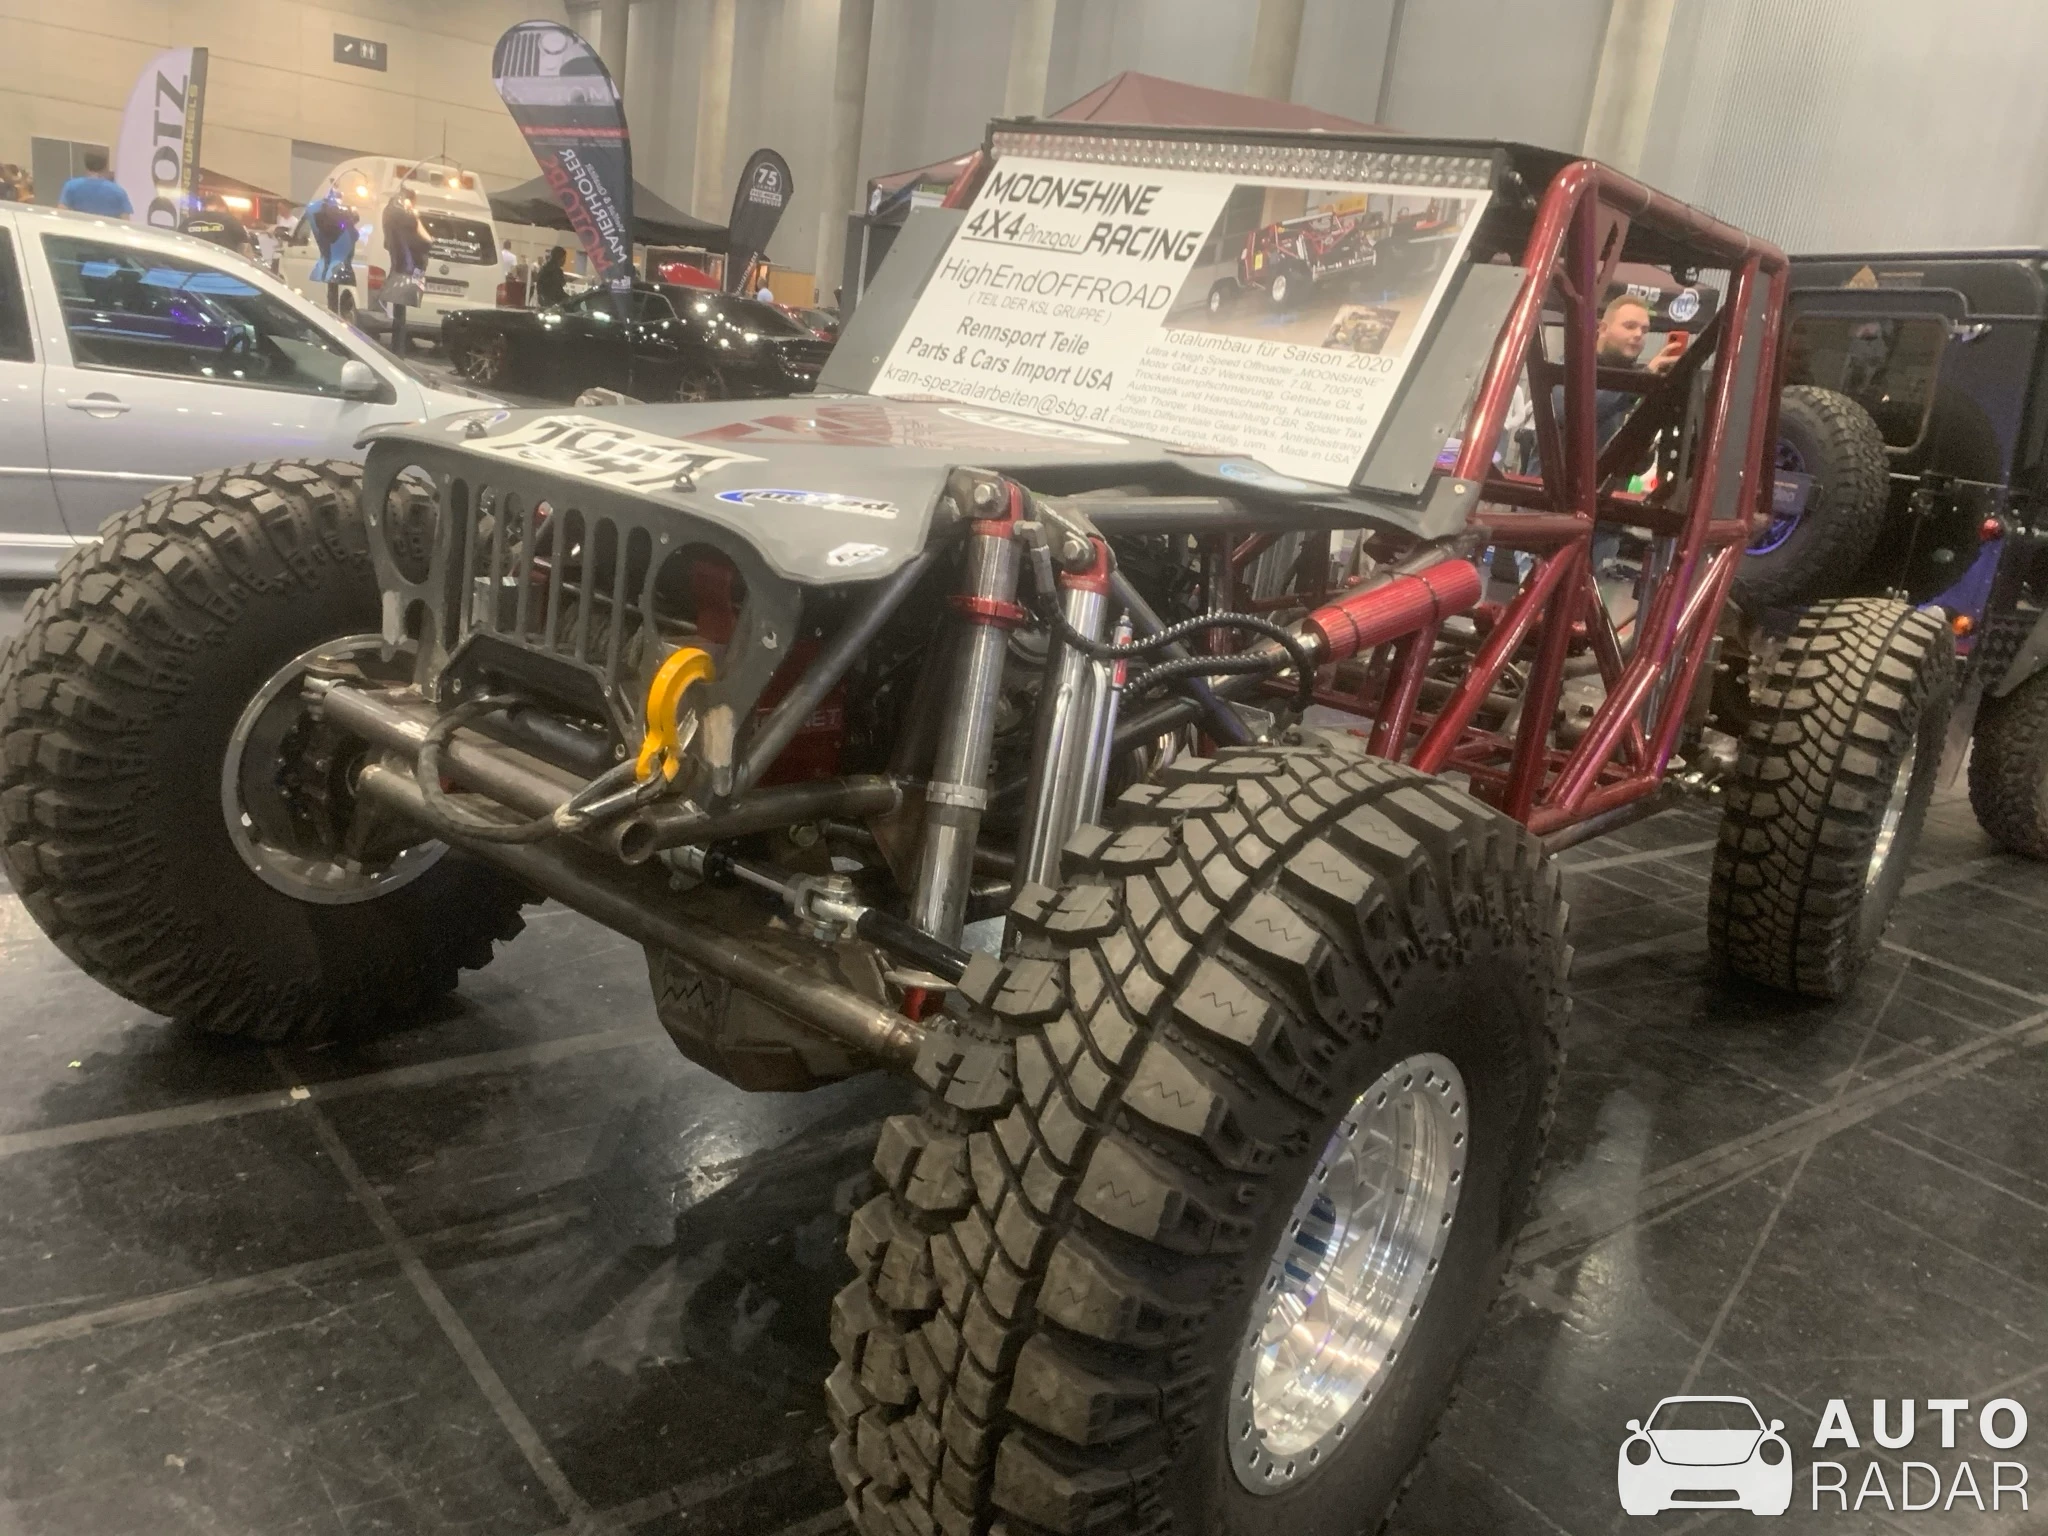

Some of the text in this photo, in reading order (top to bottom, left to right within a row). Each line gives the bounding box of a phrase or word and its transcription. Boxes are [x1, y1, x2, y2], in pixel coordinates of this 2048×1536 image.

[147, 70, 188, 230] DOTZ
[757, 168, 778, 187] 75
[984, 171, 1163, 216] MOONSHINE
[966, 208, 1027, 241] 4X4
[1079, 221, 1203, 262] RACING
[939, 256, 1172, 310] HighEndOFFROAD
[976, 291, 999, 308] TEIL
[1000, 295, 1028, 311] DER
[1027, 300, 1050, 316] KSL
[1052, 303, 1106, 323] GRUPPE
[956, 315, 1090, 356] Rennsport Teile
[1145, 346, 1170, 358] Ultra
[1179, 351, 1205, 363] High
[1206, 354, 1242, 368] Speed
[1164, 329, 1394, 374] Totalumbau für Saison 2020
[906, 336, 1113, 392] Parts & Cars Import USA
[1138, 357, 1169, 369] Motor
[1171, 362, 1192, 373] GM
[1192, 365, 1217, 376] LS7
[883, 362, 1110, 423] kran-spezialarbeiten@sbg.at
[1126, 380, 1178, 397] Automatik
[1180, 390, 1203, 401] und
[1277, 443, 1309, 458] Made
